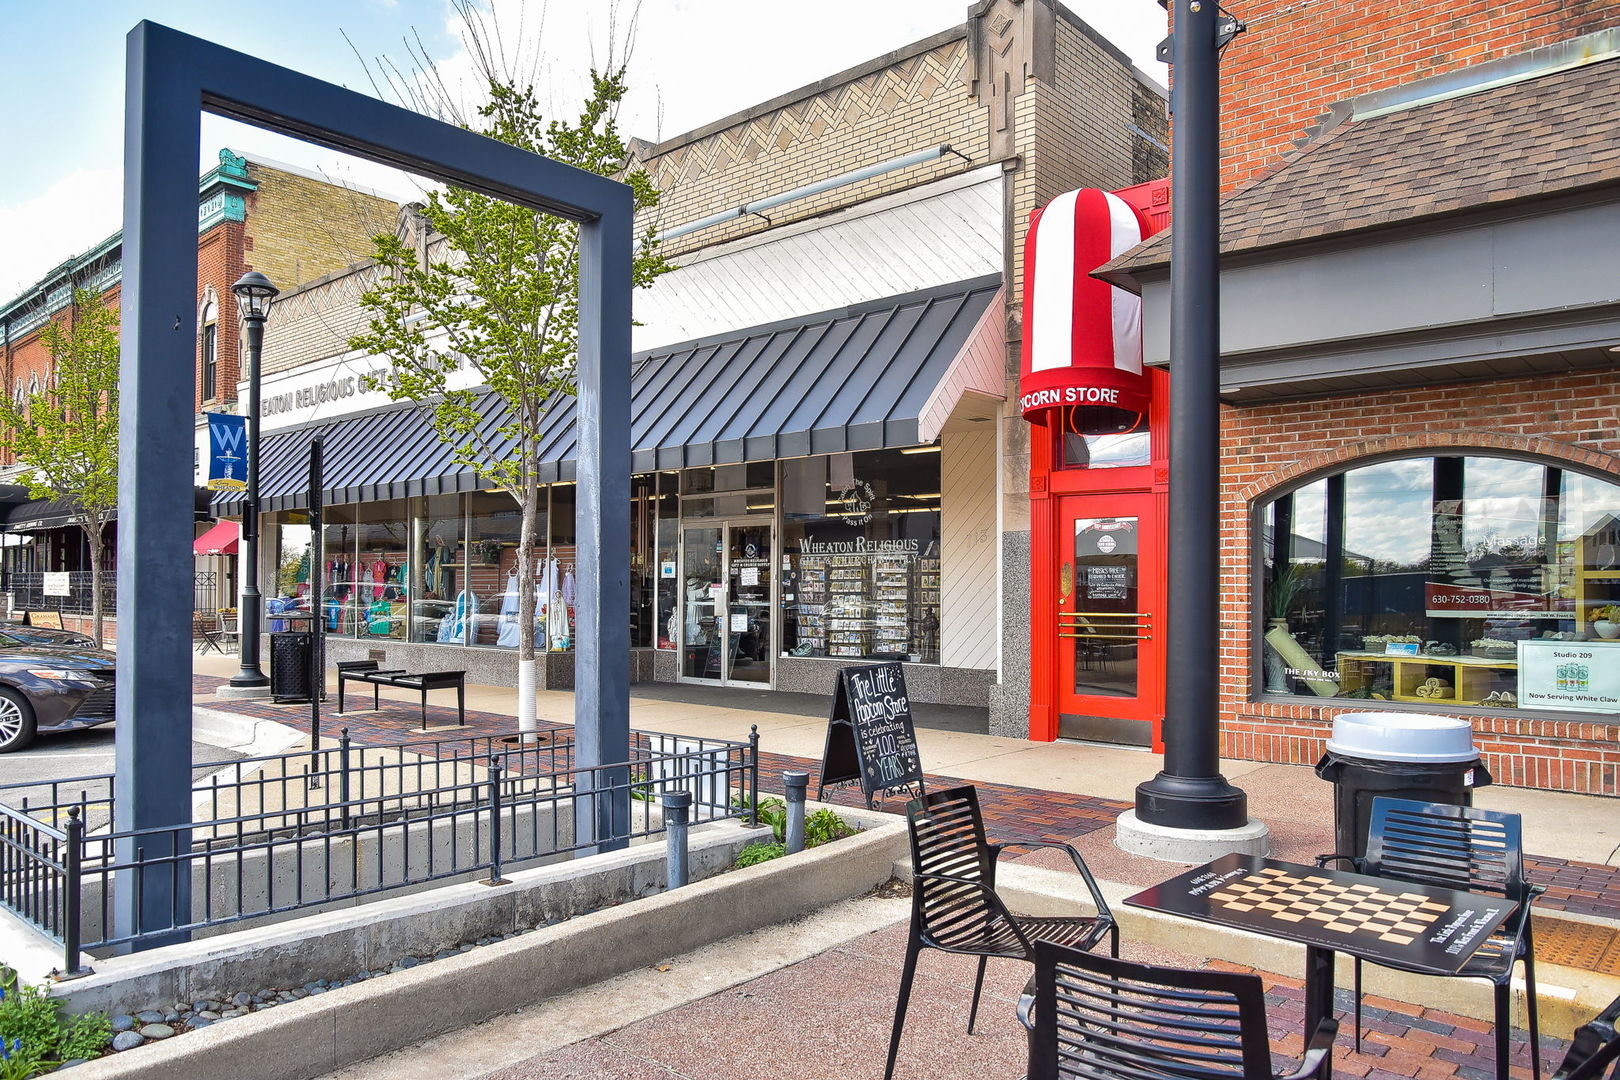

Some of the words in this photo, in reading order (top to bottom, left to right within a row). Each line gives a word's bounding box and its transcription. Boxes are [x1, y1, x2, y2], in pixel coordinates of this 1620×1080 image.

[295, 376, 355, 409] RELIGIOUS
[1065, 387, 1120, 404] STORE
[210, 423, 244, 452] W
[842, 515, 858, 527] Pass
[863, 514, 873, 523] On
[1483, 535, 1547, 548] Massage
[1432, 594, 1490, 604] 630-752-0380
[1284, 667, 1300, 676] THE
[1303, 669, 1319, 677] SKY
[1322, 671, 1340, 679] BOX
[851, 673, 873, 700] The
[869, 666, 896, 697] Little
[1547, 693, 1574, 702] Serving
[854, 698, 889, 726] Popcorn
[883, 695, 908, 720] Store
[860, 729, 868, 739] is
[869, 721, 905, 737] celebrating
[876, 734, 897, 756] 100
[876, 753, 904, 781] YEARS
